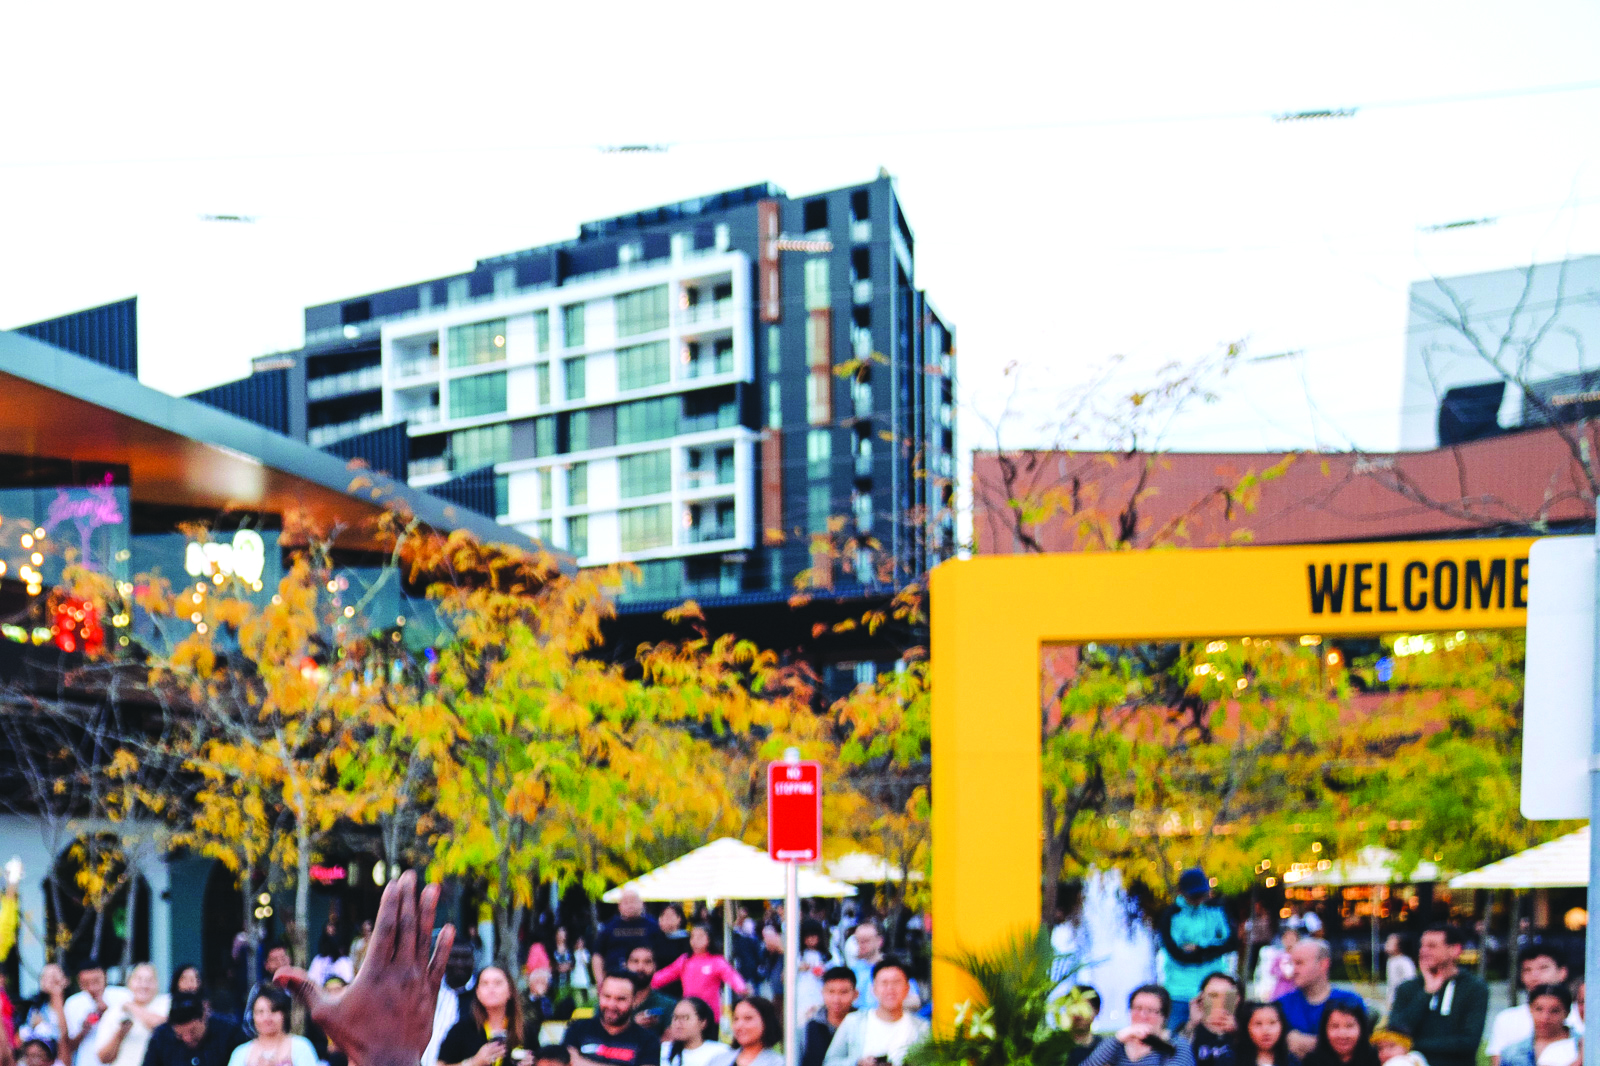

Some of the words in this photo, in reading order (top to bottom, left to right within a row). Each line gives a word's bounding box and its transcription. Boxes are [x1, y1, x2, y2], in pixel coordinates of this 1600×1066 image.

[1307, 558, 1529, 614] WELCOME
[786, 767, 802, 780] NO
[775, 781, 814, 796] STOPPING
